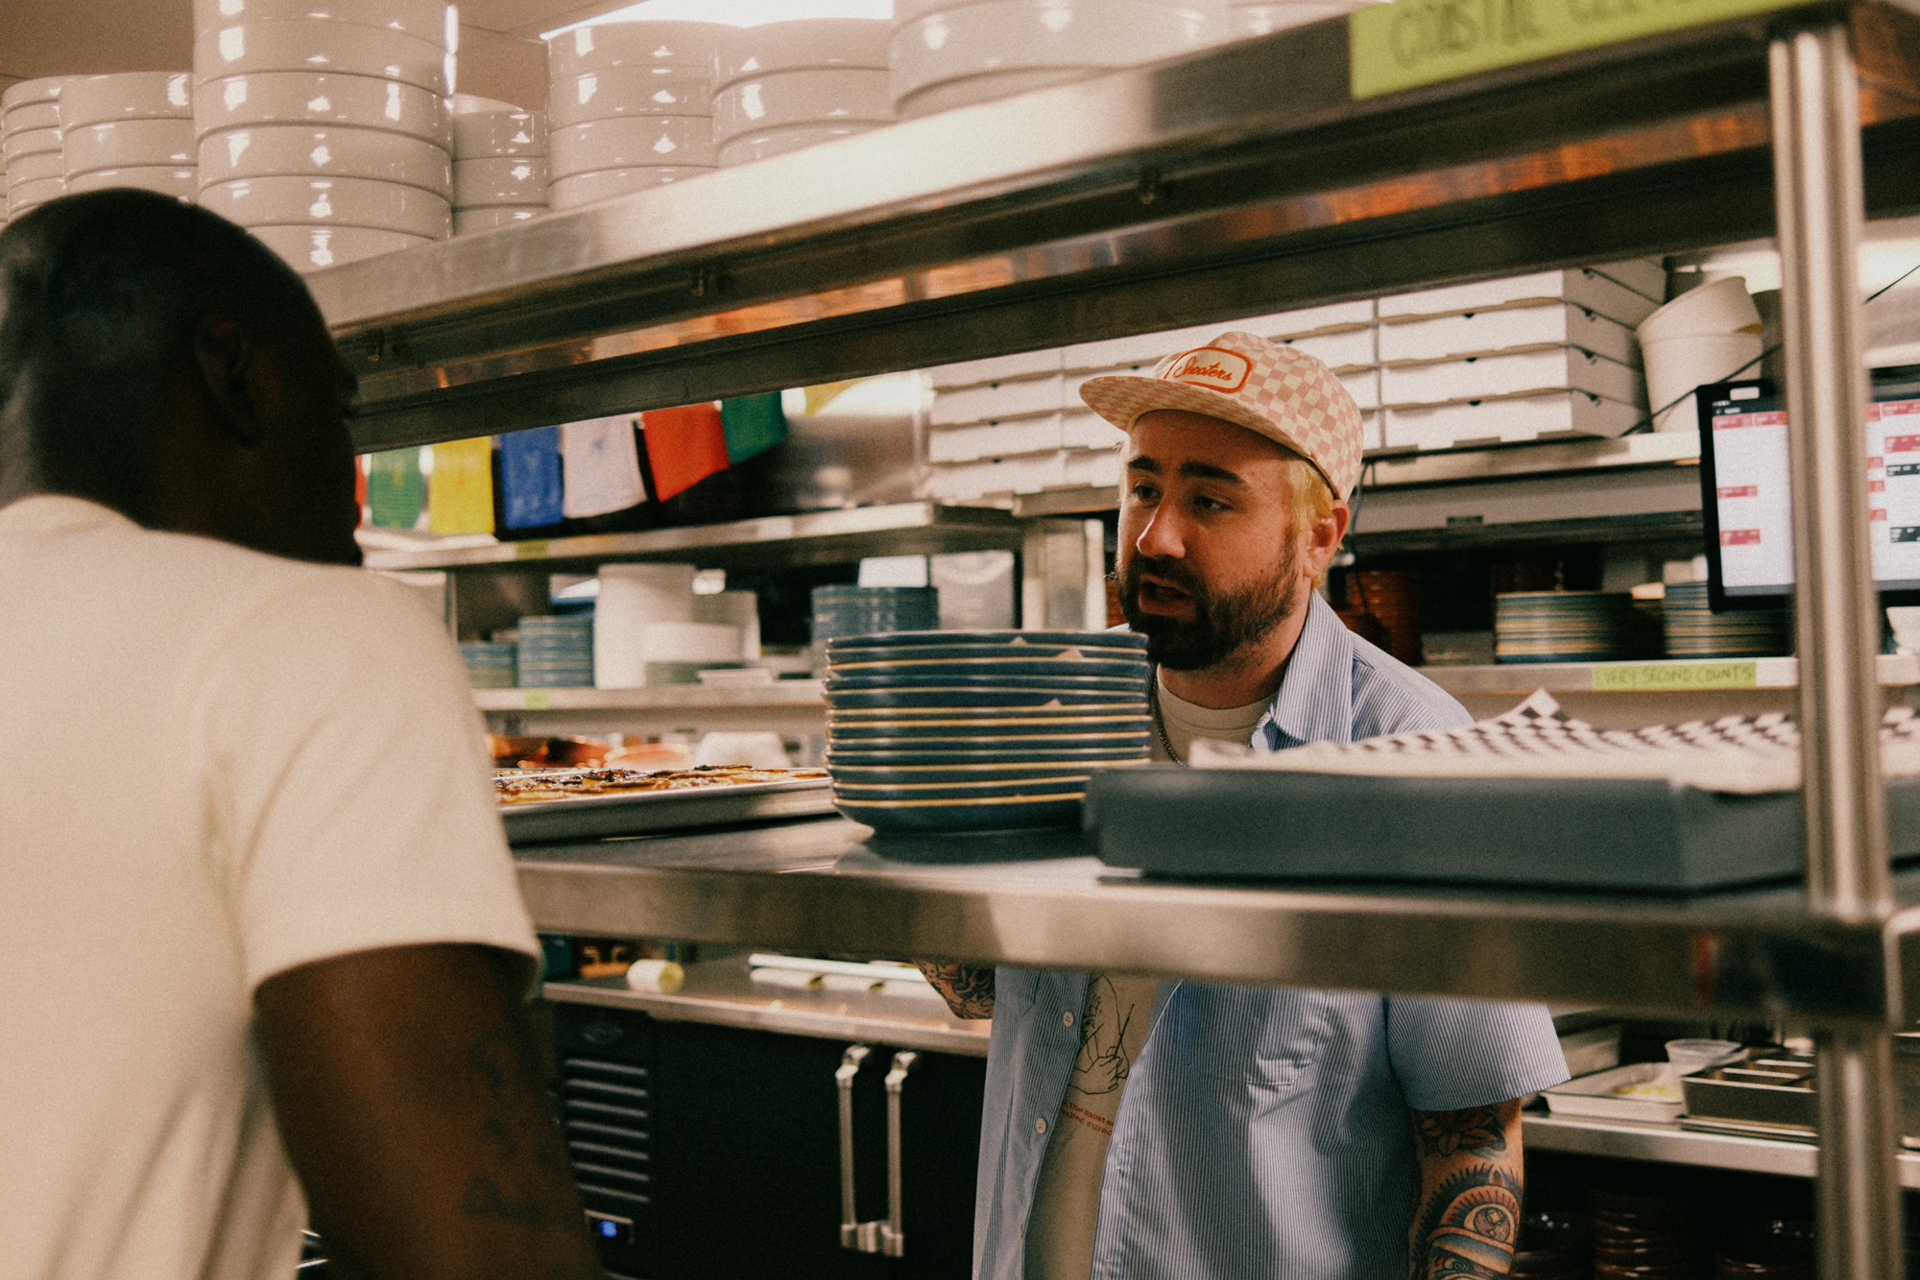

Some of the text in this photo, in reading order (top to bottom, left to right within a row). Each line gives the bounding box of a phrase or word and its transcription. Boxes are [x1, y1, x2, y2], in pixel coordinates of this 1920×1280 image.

[1172, 356, 1233, 381] Shooters
[1697, 662, 1752, 681] COUNTS
[1084, 1110, 1106, 1123] most
